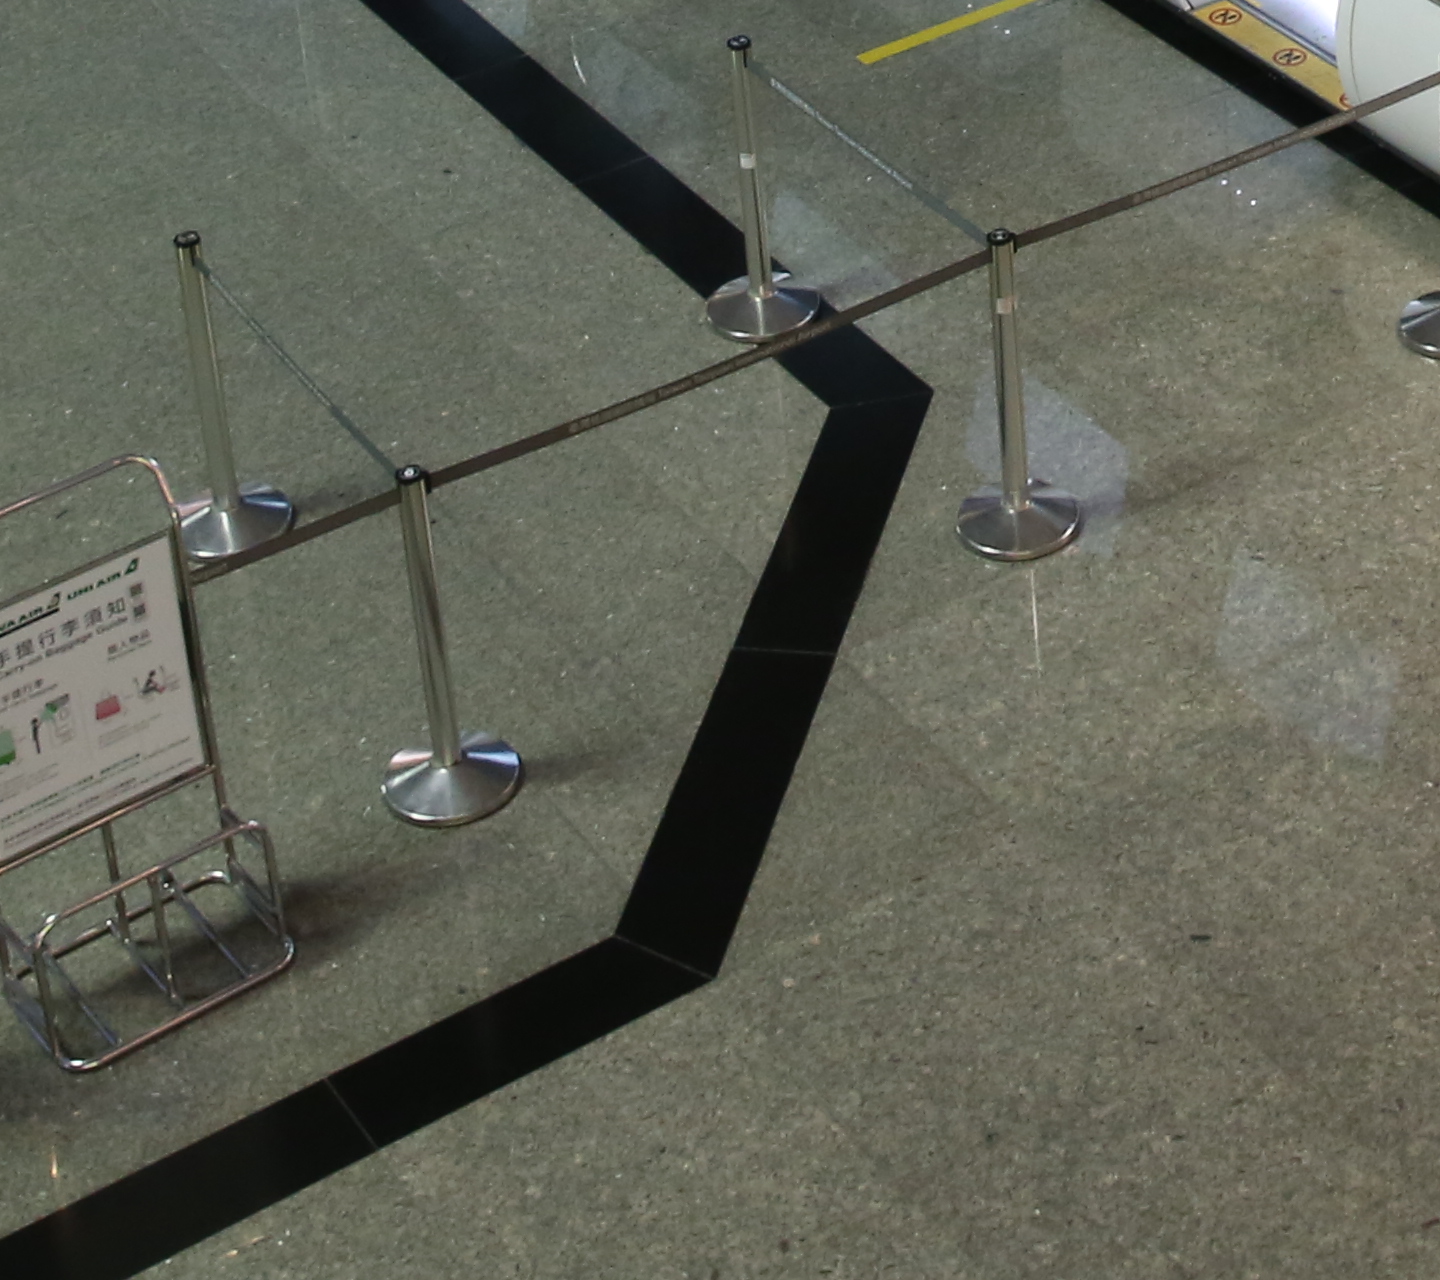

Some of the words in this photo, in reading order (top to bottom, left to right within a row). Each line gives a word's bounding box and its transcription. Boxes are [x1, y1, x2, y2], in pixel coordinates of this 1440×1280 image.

[17, 606, 43, 624] AIR
[66, 584, 94, 601] UNI
[96, 571, 122, 588] AIR
[45, 632, 94, 658] Baggage
[96, 615, 128, 635] Guide
